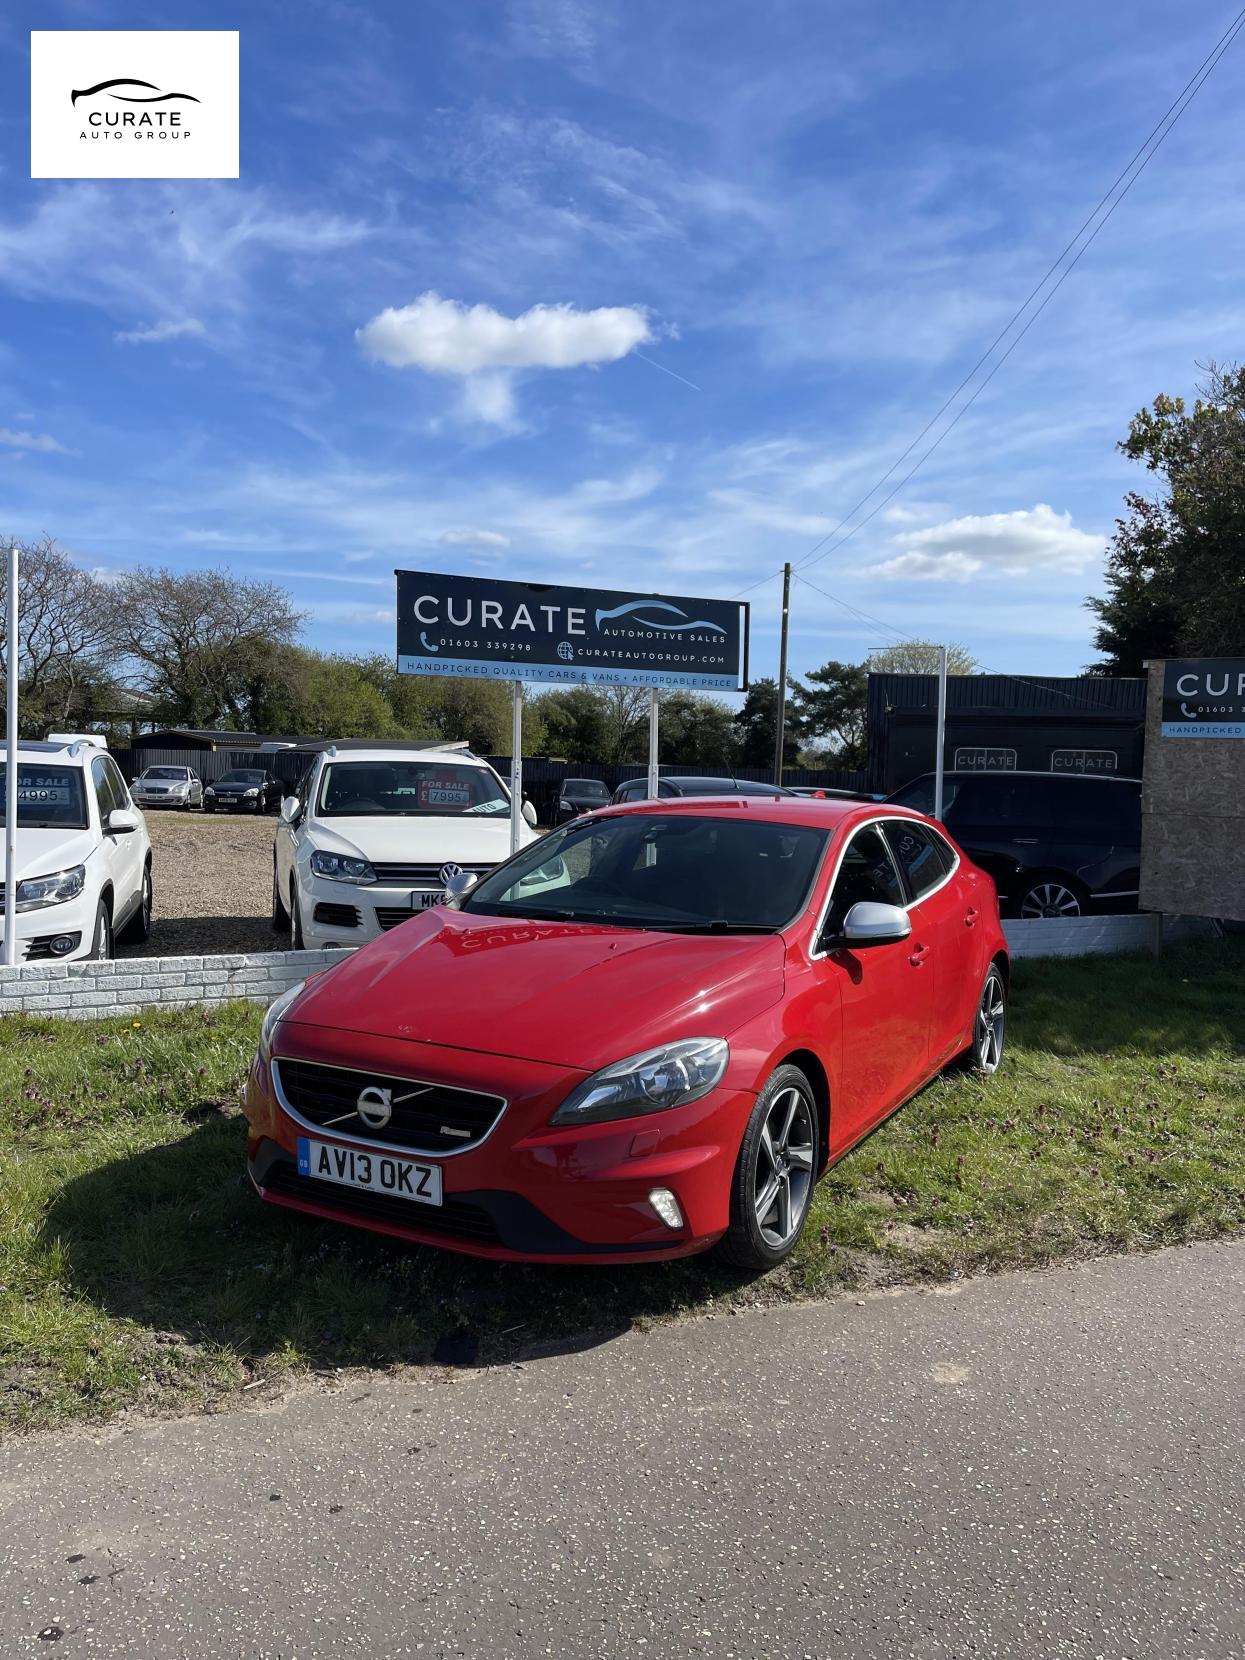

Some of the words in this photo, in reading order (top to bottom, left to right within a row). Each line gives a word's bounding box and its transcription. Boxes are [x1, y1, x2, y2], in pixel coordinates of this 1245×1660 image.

[413, 595, 586, 635] CURATE
[603, 628, 684, 641] AUTOMOTIVE
[690, 634, 726, 644] SALES
[440, 638, 479, 648] 01603
[486, 641, 532, 652] 339298
[578, 648, 725, 664] CURATEAUTOGROUP.COM
[407, 661, 488, 675] HANDPICKED
[493, 666, 543, 677] QUALITY
[548, 670, 577, 680] CARS
[580, 671, 587, 680] &
[591, 672, 620, 682] VANS
[632, 675, 698, 687] AFFORDABLE
[701, 678, 732, 688] PRICE
[1169, 726, 1242, 734] HANDPICKED
[957, 756, 1014, 766] CURATE
[1054, 757, 1113, 769] CURATE
[35, 778, 69, 786] SALE
[421, 780, 442, 789] FOR
[445, 782, 470, 790] SALE
[318, 1145, 372, 1184] AV13
[380, 1159, 432, 1198] OKZ
